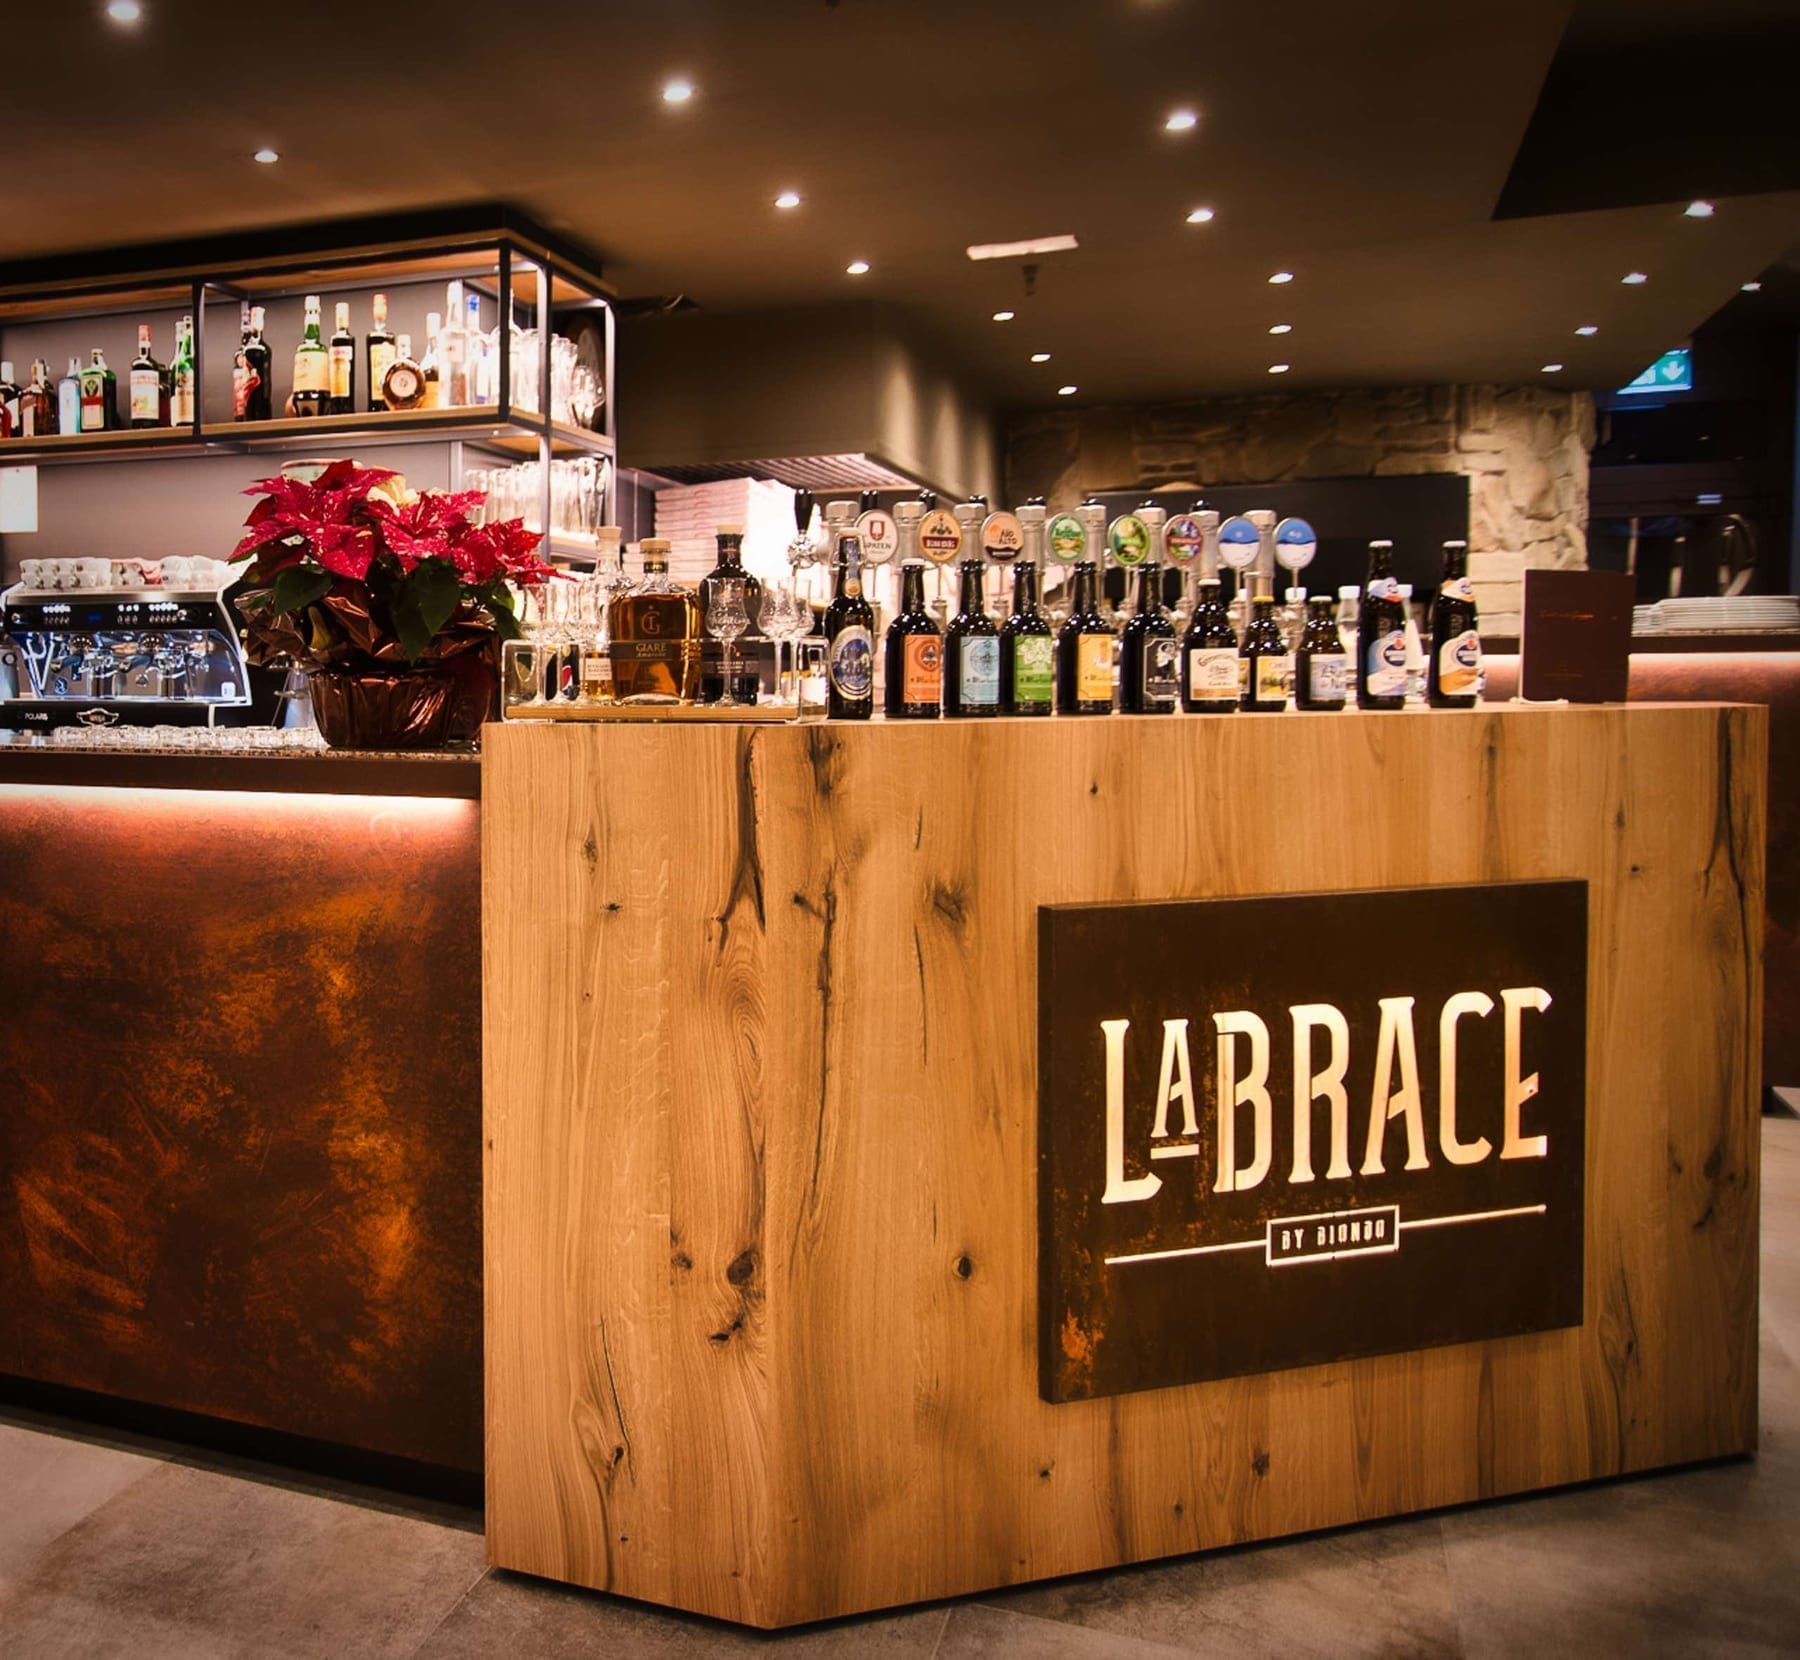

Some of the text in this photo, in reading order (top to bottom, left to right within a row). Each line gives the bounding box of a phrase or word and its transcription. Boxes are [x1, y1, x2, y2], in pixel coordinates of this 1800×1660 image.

[635, 642, 667, 653] GIARE
[24, 712, 49, 721] POLARIS
[1281, 1219, 1386, 1251] BY BIONDO
